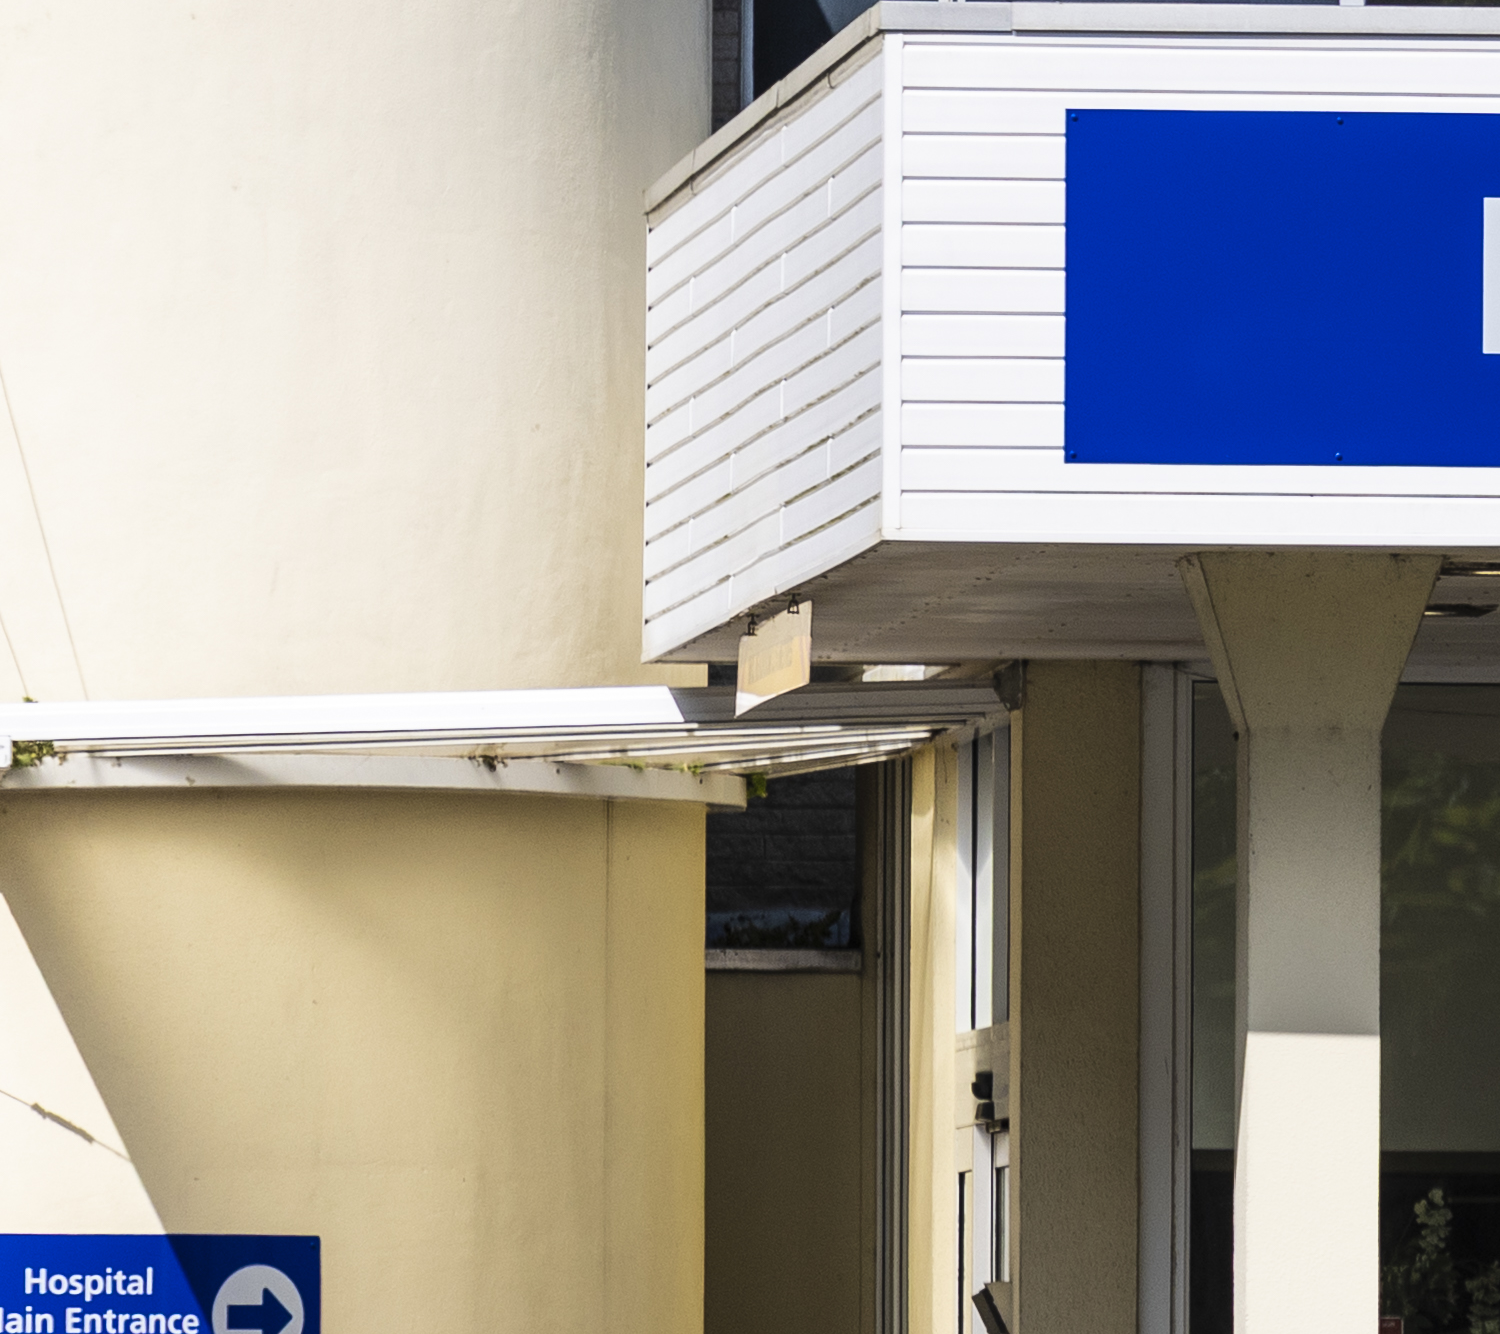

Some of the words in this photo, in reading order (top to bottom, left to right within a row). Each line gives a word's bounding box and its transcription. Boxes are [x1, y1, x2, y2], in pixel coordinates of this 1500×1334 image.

[24, 1267, 154, 1302] Hospital
[0, 1305, 54, 1334] ain
[65, 1307, 200, 1334] Entrance
